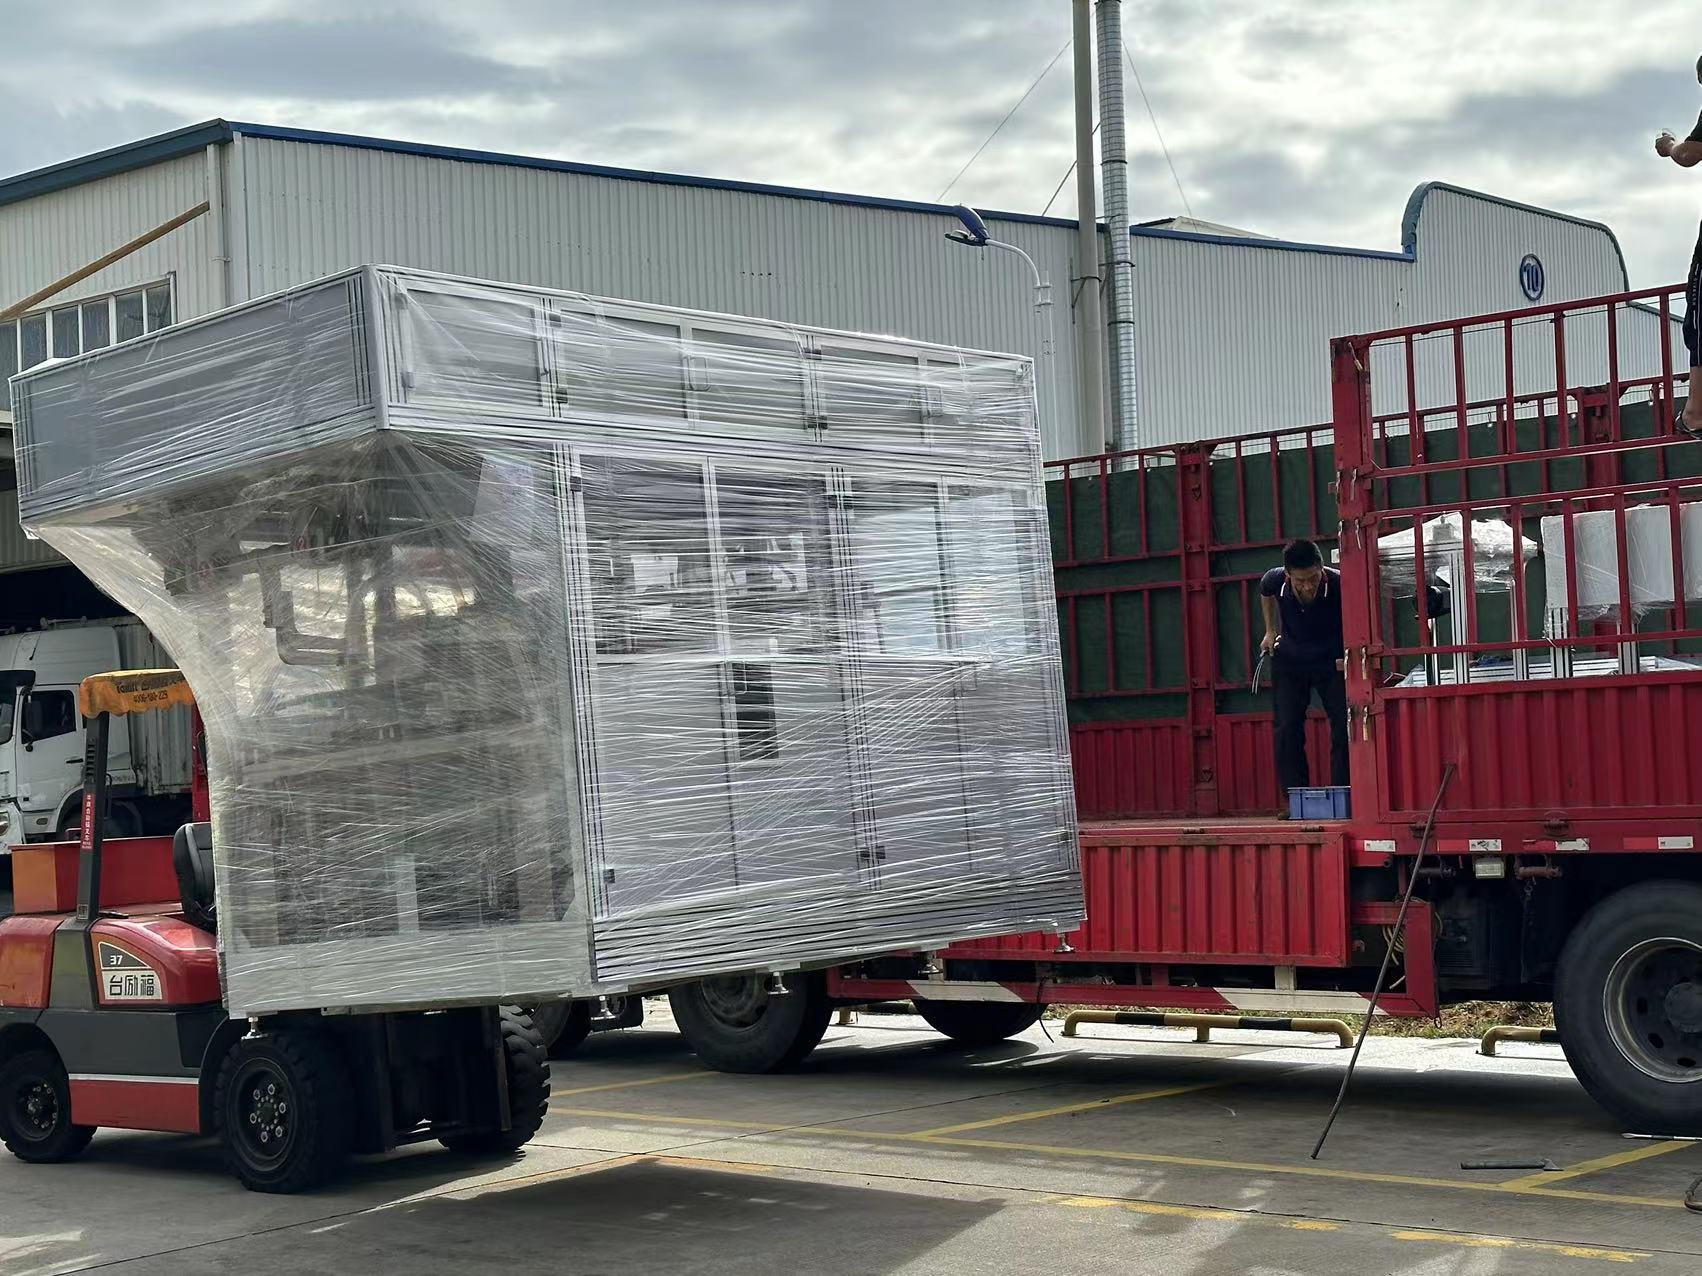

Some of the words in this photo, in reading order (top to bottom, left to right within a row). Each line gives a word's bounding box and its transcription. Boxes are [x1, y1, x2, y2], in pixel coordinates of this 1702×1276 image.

[1523, 262, 1540, 292] 10
[110, 955, 123, 965] 37
[109, 975, 154, 996] 台励福
